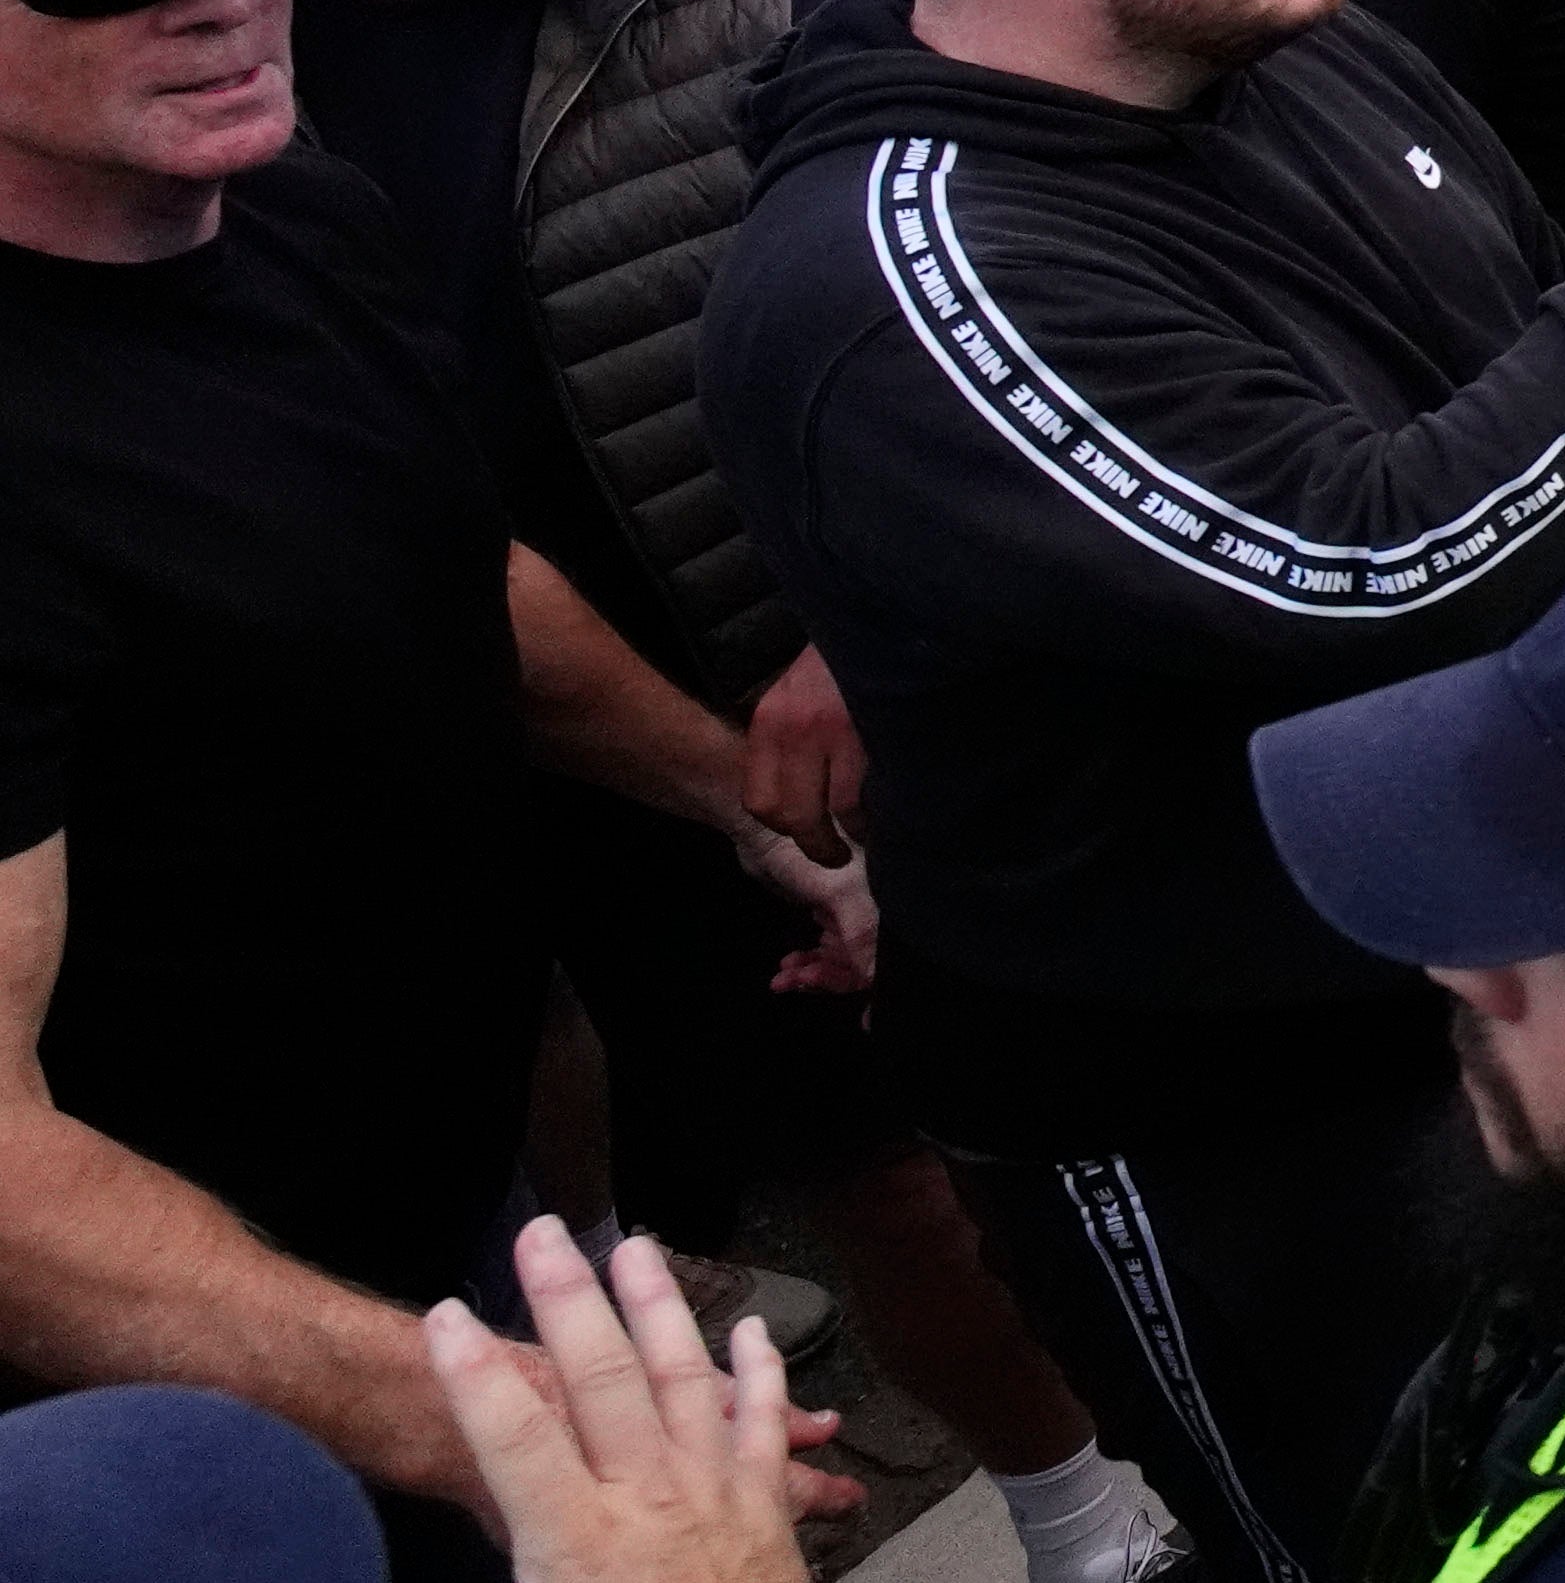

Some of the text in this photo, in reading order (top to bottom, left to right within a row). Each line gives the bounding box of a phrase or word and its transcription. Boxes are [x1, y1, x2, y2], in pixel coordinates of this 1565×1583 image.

[900, 137, 933, 171] NIK
[895, 207, 930, 255] NIKE
[911, 253, 964, 321] NIKE
[951, 320, 1013, 386] NIKE
[1006, 382, 1074, 445] NIKE
[1069, 439, 1142, 500] NIKE
[1137, 491, 1210, 543] NIKE
[1500, 472, 1565, 528] NIKE
[1211, 531, 1286, 577] NIKE
[1432, 523, 1499, 573] NIKE
[1287, 563, 1353, 593] NIKE
[1366, 564, 1429, 596] NIKE
[1092, 1185, 1136, 1251] NIKE
